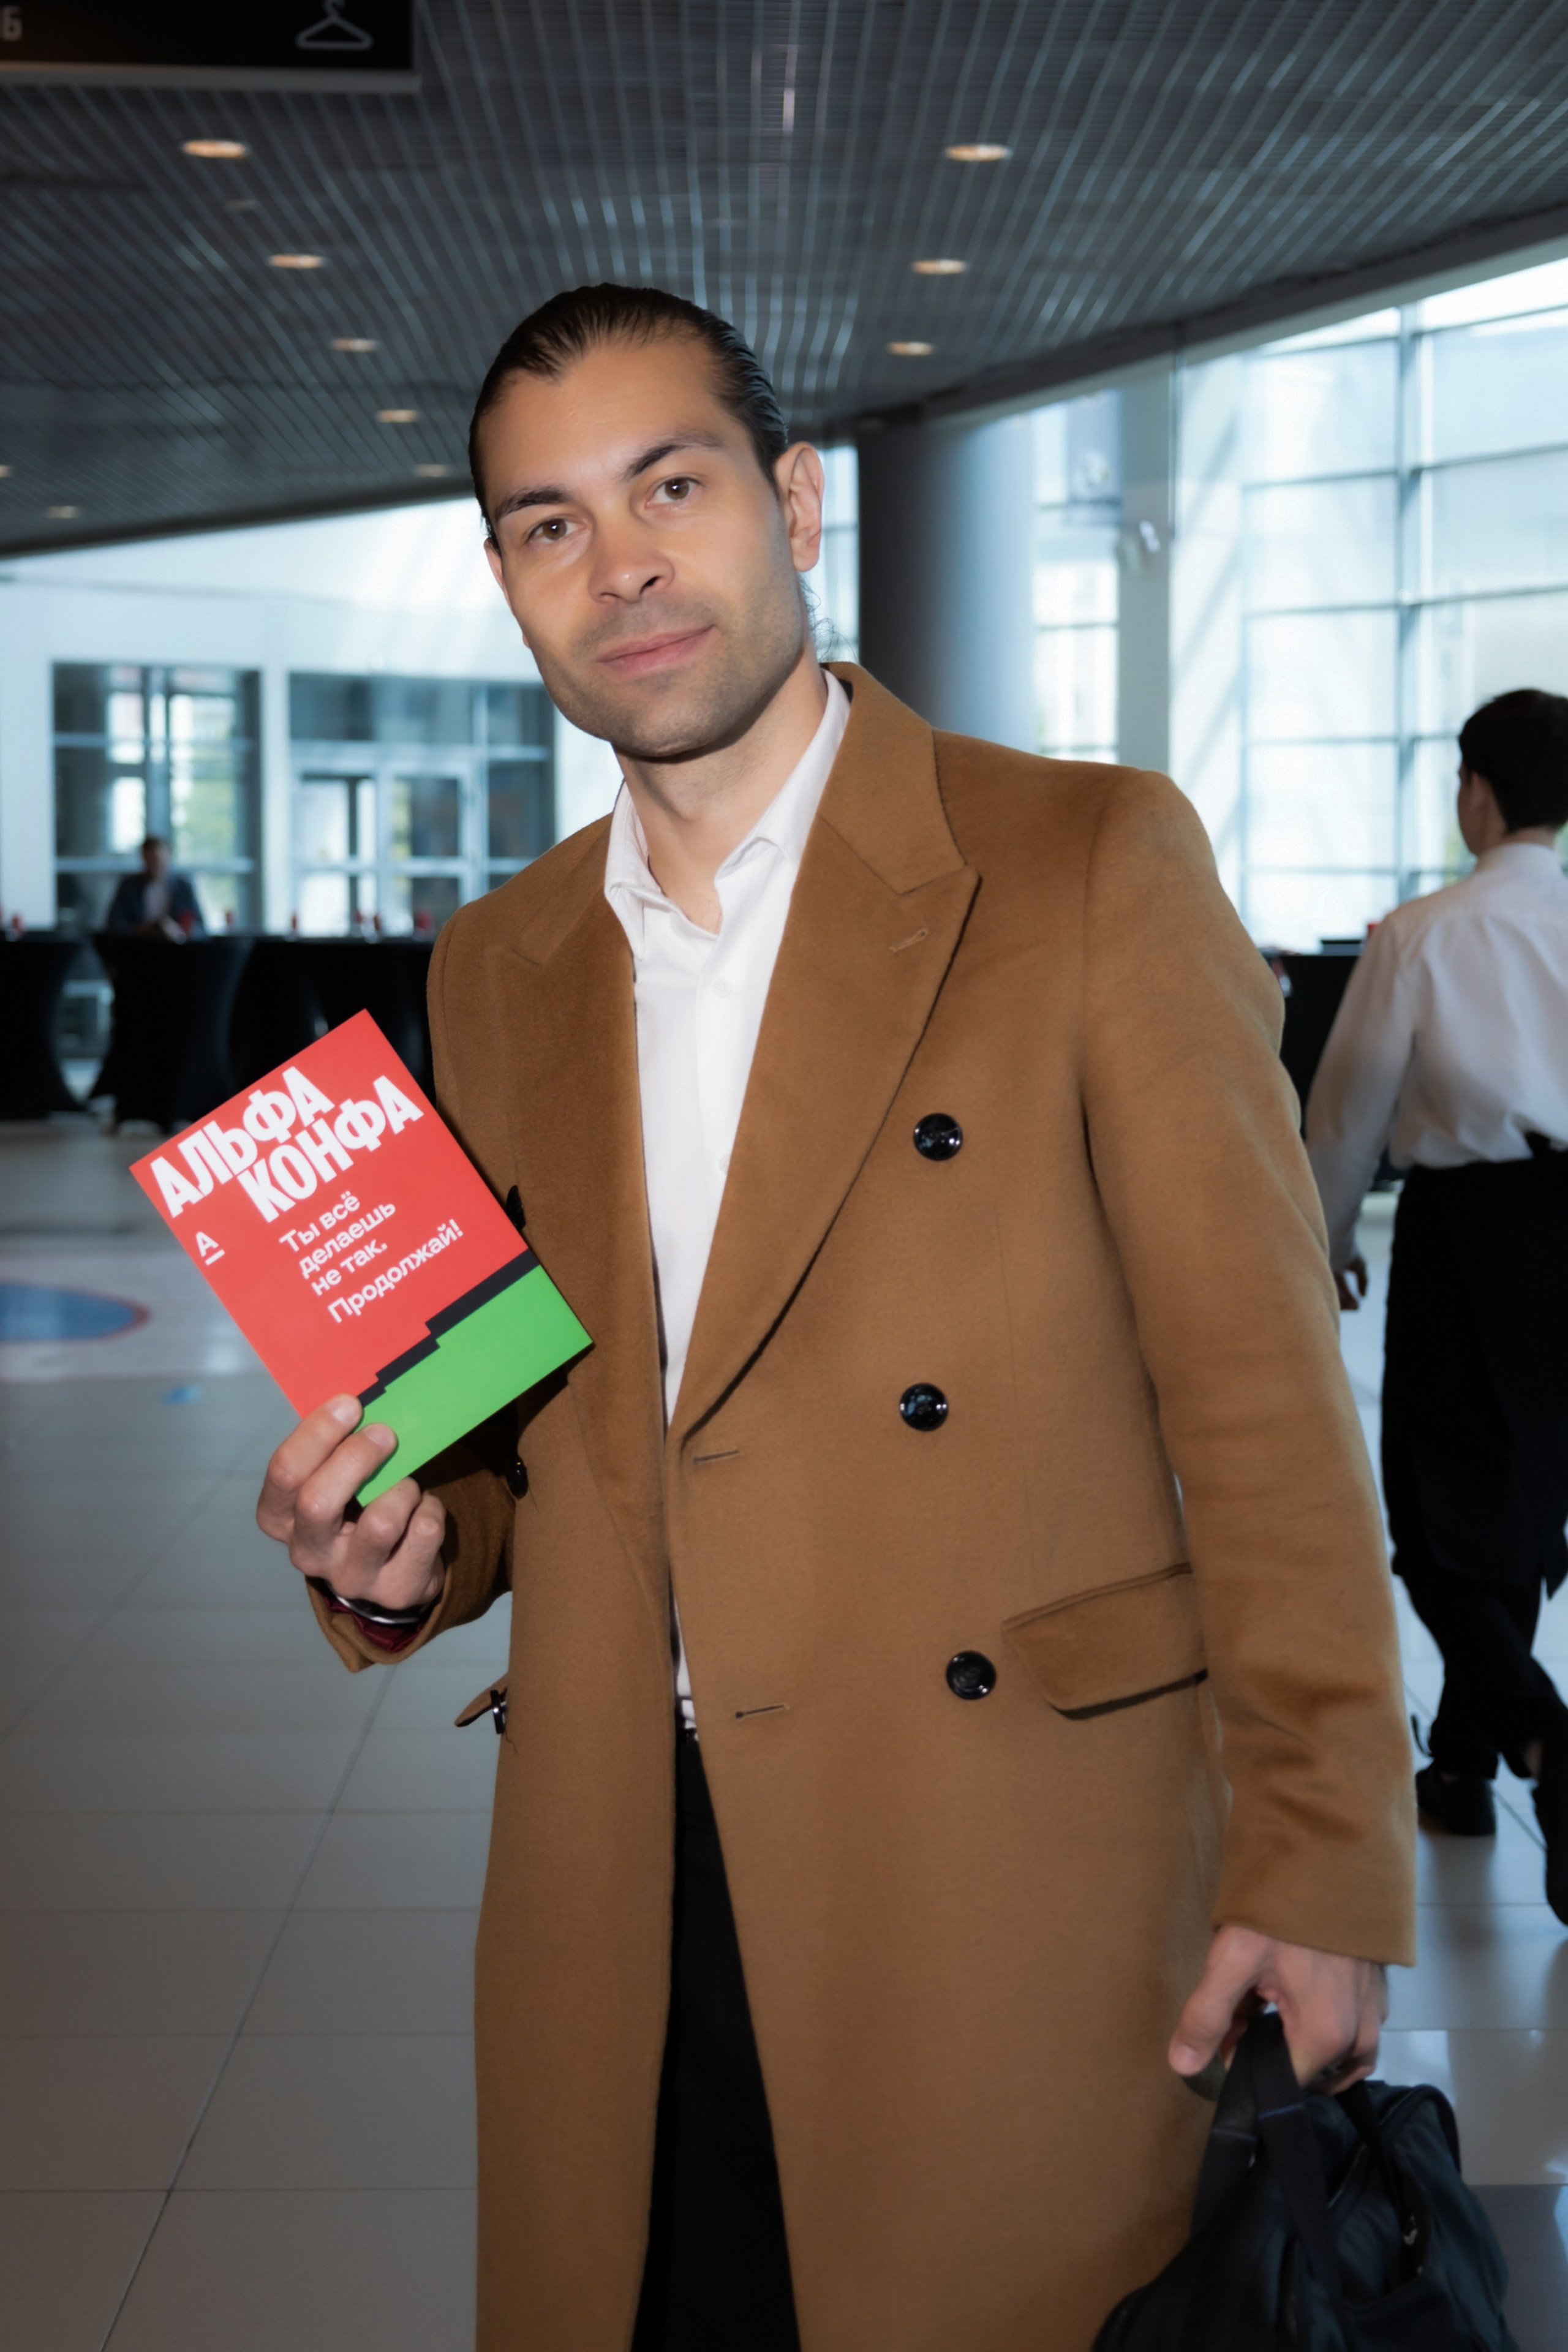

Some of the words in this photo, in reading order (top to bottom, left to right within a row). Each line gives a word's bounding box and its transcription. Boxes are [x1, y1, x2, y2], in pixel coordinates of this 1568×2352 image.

[150, 1066, 335, 1218] АЛЬФА
[236, 1075, 424, 1223] КОНФА
[279, 1223, 321, 1252] Ты
[318, 1190, 360, 1231] всё
[299, 1203, 396, 1280] делаешь
[311, 1268, 342, 1296] не
[339, 1239, 388, 1273] так.
[327, 1218, 464, 1324] Продолжай!
